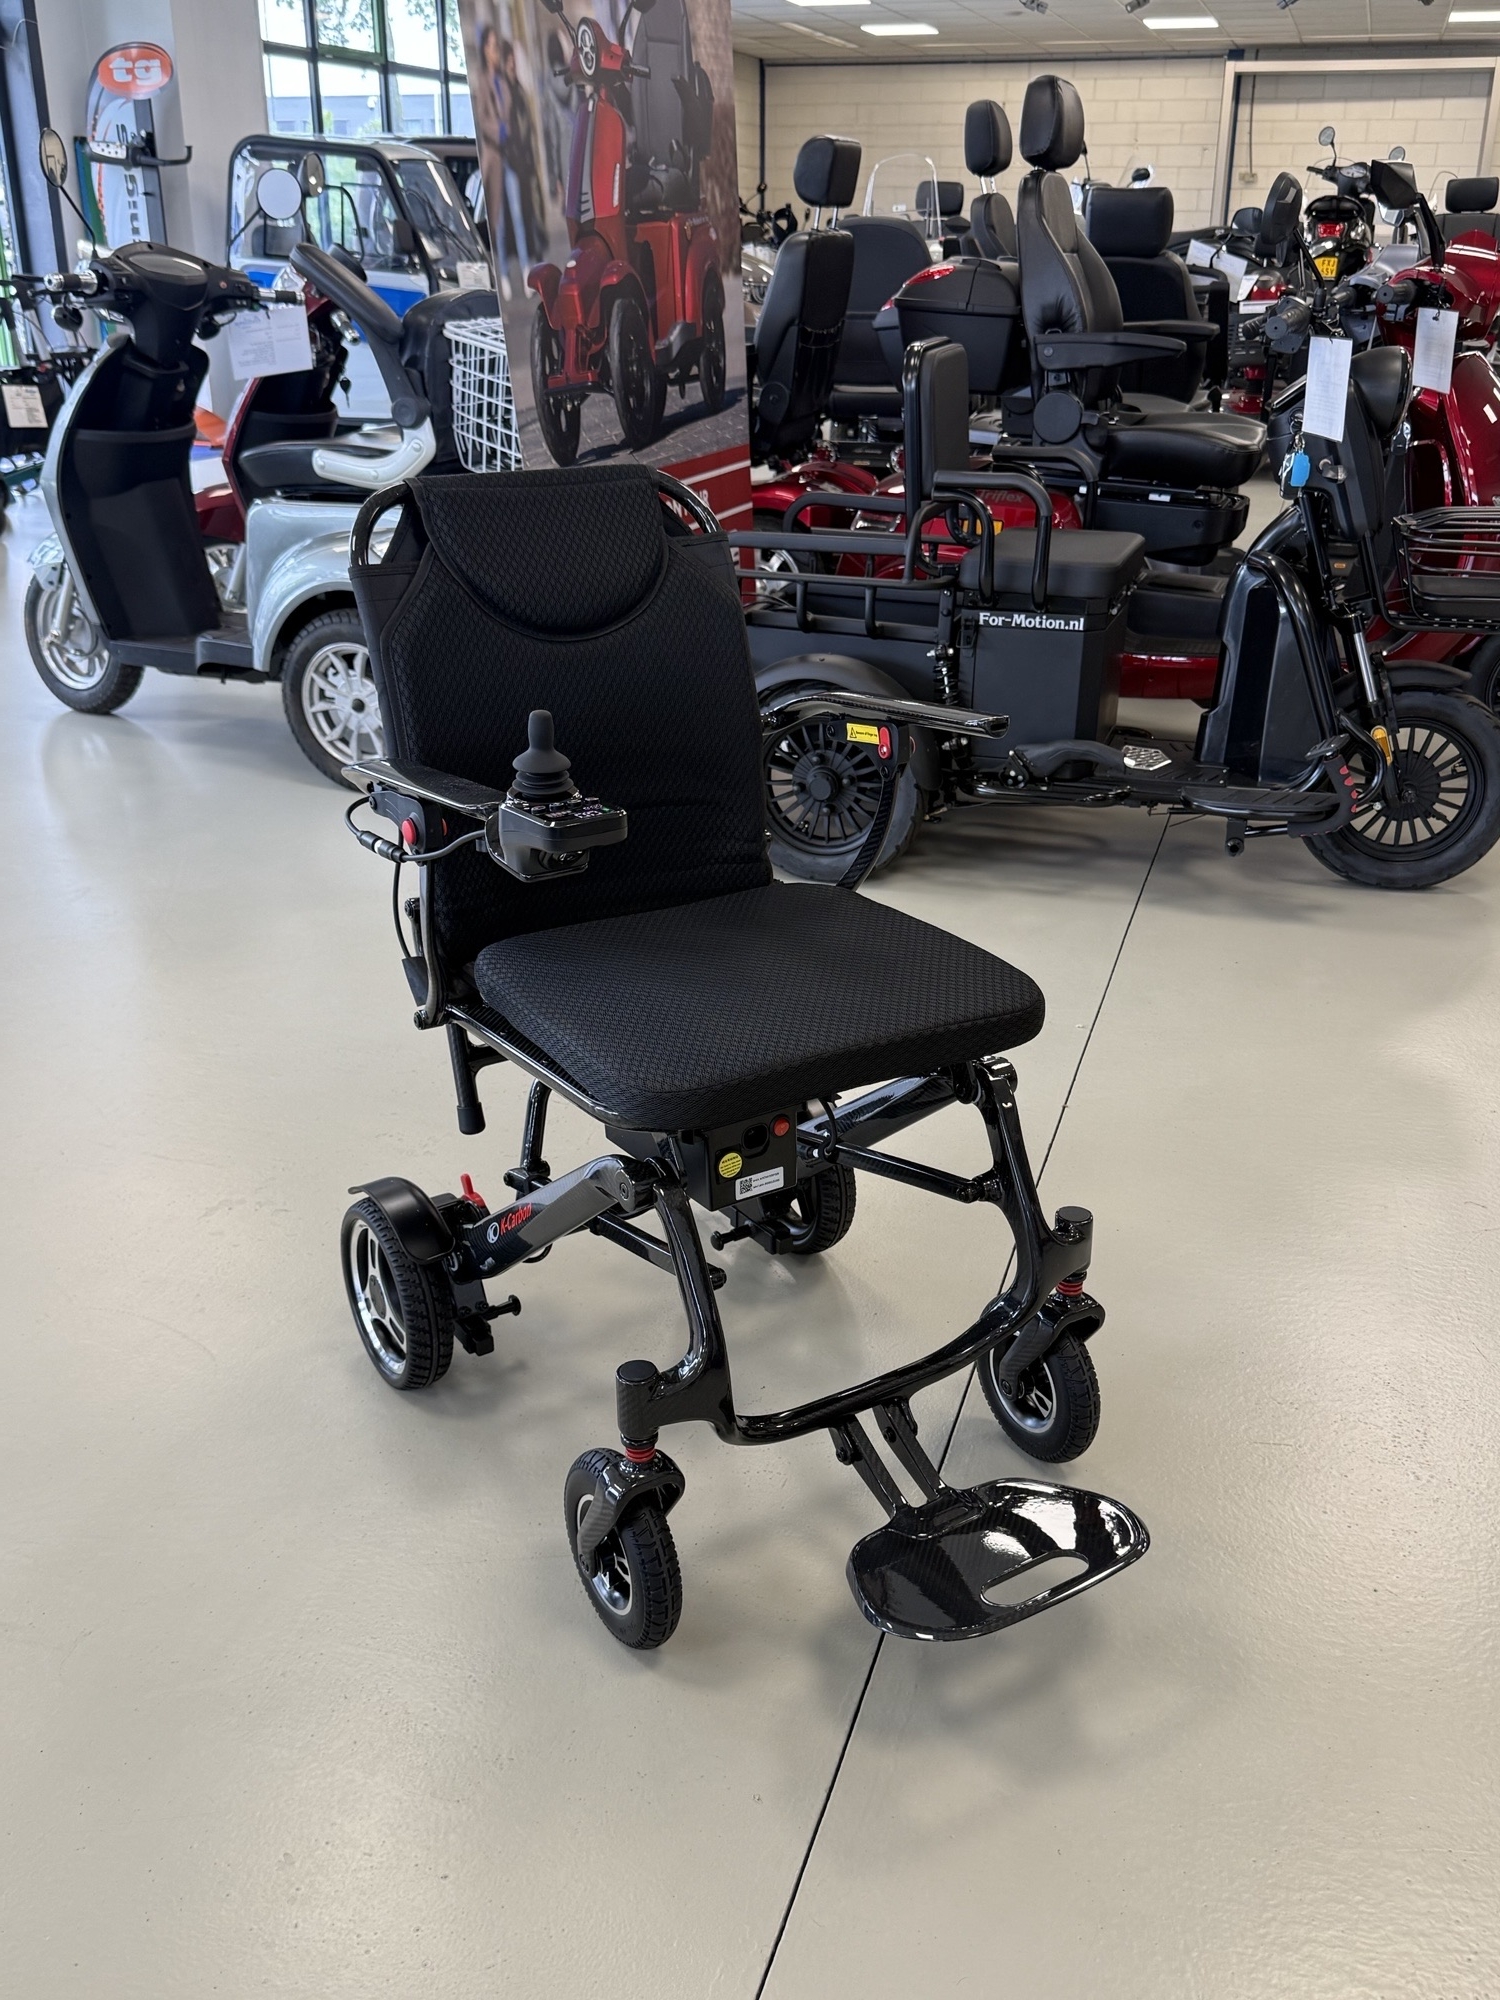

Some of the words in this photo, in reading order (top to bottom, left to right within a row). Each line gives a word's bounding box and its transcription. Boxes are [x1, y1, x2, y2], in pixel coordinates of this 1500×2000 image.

[109, 57, 162, 86] tg
[975, 489, 1024, 503] Triflex
[979, 612, 1084, 631] For-Motion.nl
